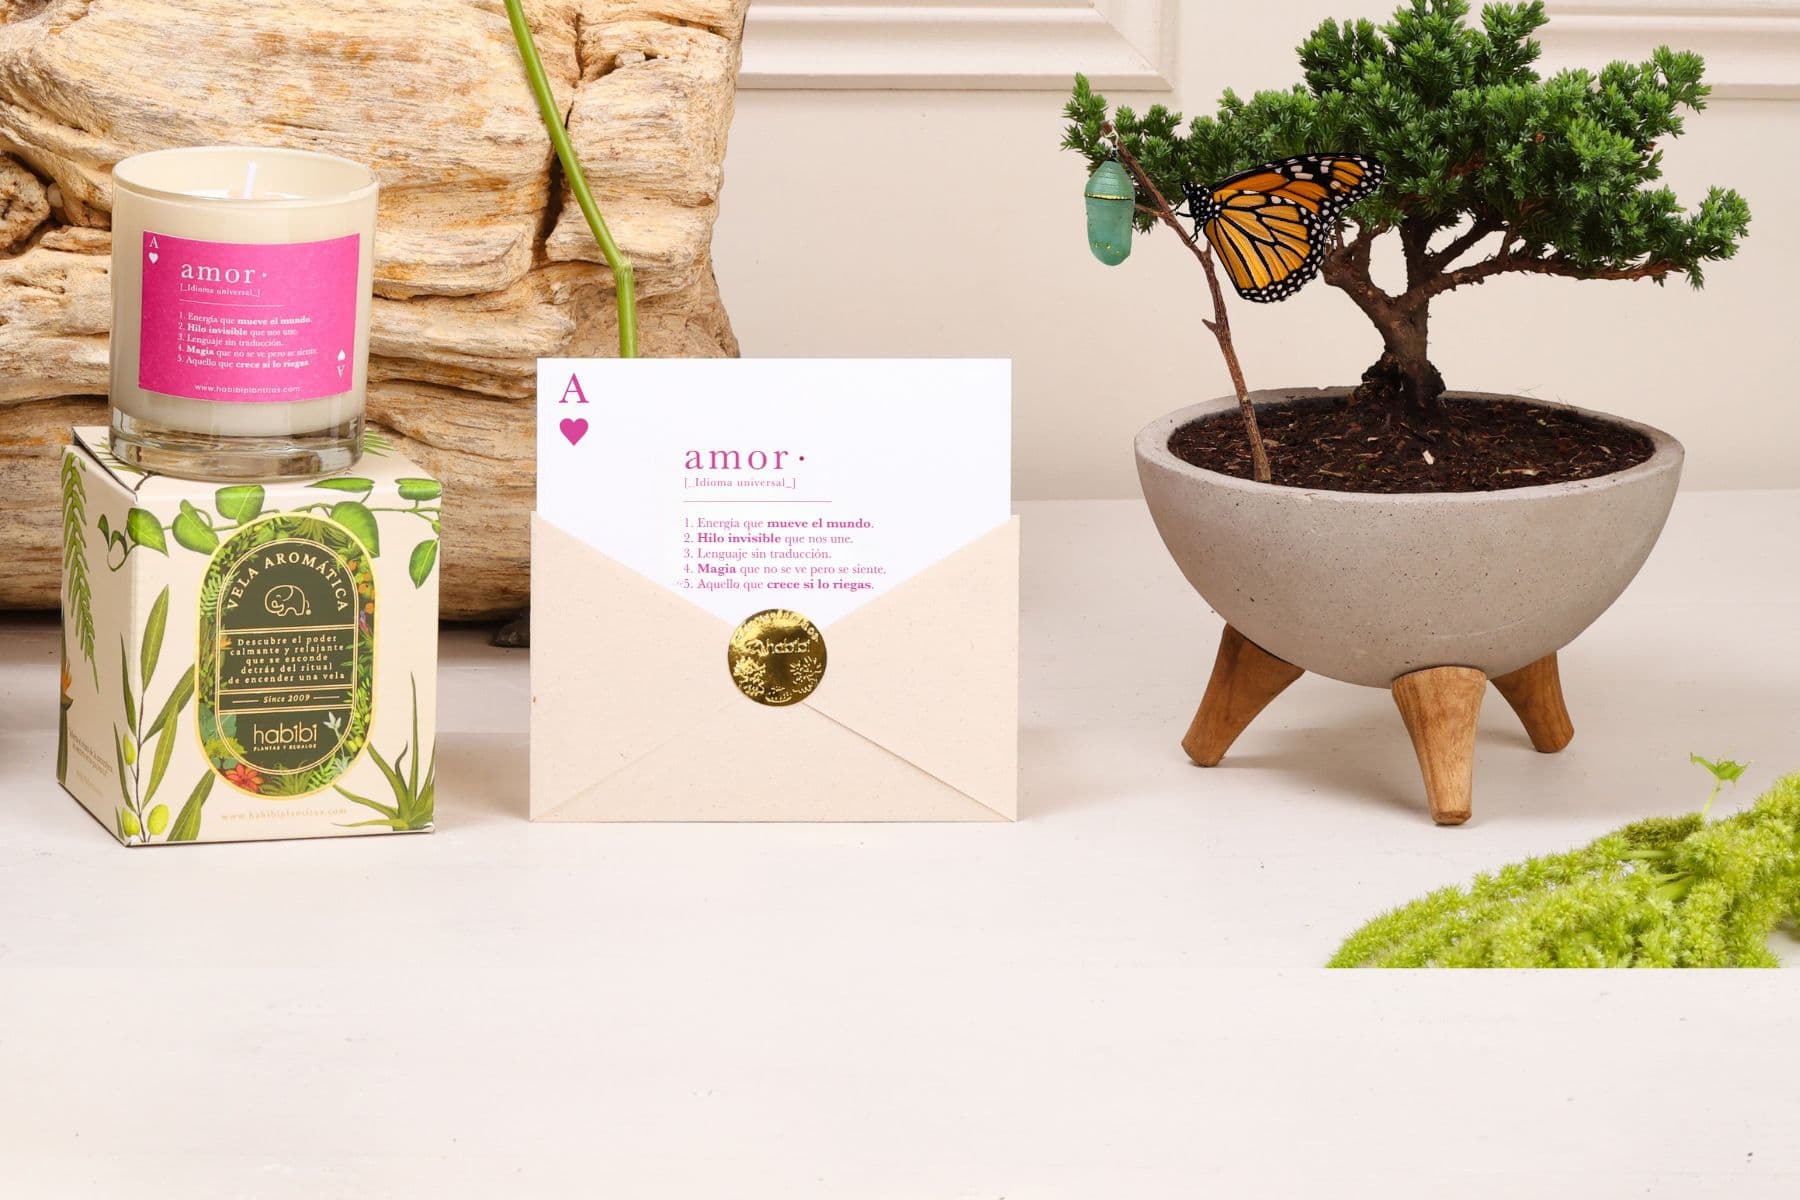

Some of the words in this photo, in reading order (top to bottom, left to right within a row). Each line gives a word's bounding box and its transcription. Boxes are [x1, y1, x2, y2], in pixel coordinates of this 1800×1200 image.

[149, 235, 160, 249] A
[270, 317, 278, 325] el
[178, 322, 185, 330] 2.
[187, 322, 207, 333] Hilo
[209, 325, 248, 336] invisible
[178, 333, 185, 341] 3.
[187, 334, 223, 347] Lenguaje
[187, 344, 214, 356] Magia
[216, 350, 231, 358] que
[186, 356, 217, 367] Aquello
[262, 360, 271, 368] si
[272, 360, 281, 368] lo
[558, 373, 590, 404] A
[685, 517, 694, 528] 1.
[743, 520, 764, 531] que
[811, 518, 823, 528] el
[826, 518, 874, 528] mundo.
[683, 532, 694, 543] 2.
[697, 532, 725, 543] Hilo
[727, 532, 782, 543] invisible
[784, 535, 805, 546] que
[808, 536, 828, 544] nos
[830, 536, 854, 544] une.
[683, 547, 694, 559] 3.
[697, 547, 748, 561] Lenguaje
[751, 548, 766, 559] sin
[770, 548, 832, 559] traducción.
[683, 563, 694, 574] 4.
[697, 563, 737, 576] Magia
[739, 566, 761, 577] que
[763, 566, 778, 574] no
[780, 566, 792, 574] se
[794, 566, 807, 574] ve
[810, 566, 836, 577] pero
[838, 566, 849, 574] se
[852, 563, 887, 575] siente.
[227, 567, 260, 609] VELA
[265, 551, 349, 612] AROMÁTICA
[683, 578, 694, 589] 5.
[697, 578, 740, 592] Aquello
[743, 581, 764, 592] que
[803, 579, 814, 589] si
[817, 579, 830, 589] lo
[833, 579, 874, 592] riegas.
[238, 636, 288, 646] Descubre
[292, 636, 302, 644] el
[306, 634, 337, 645] poder
[230, 647, 280, 656] calmante
[284, 647, 290, 655] y
[295, 644, 344, 654] relajante
[246, 658, 265, 667] que
[284, 653, 329, 663] esconde
[241, 666, 275, 675] detrás
[280, 664, 297, 673] del
[301, 662, 333, 672] ritual
[228, 676, 241, 685] de
[245, 674, 295, 684] encender
[323, 671, 345, 680] vela
[263, 696, 285, 704] Since
[287, 694, 311, 703] 2009
[253, 722, 318, 744] habibi
